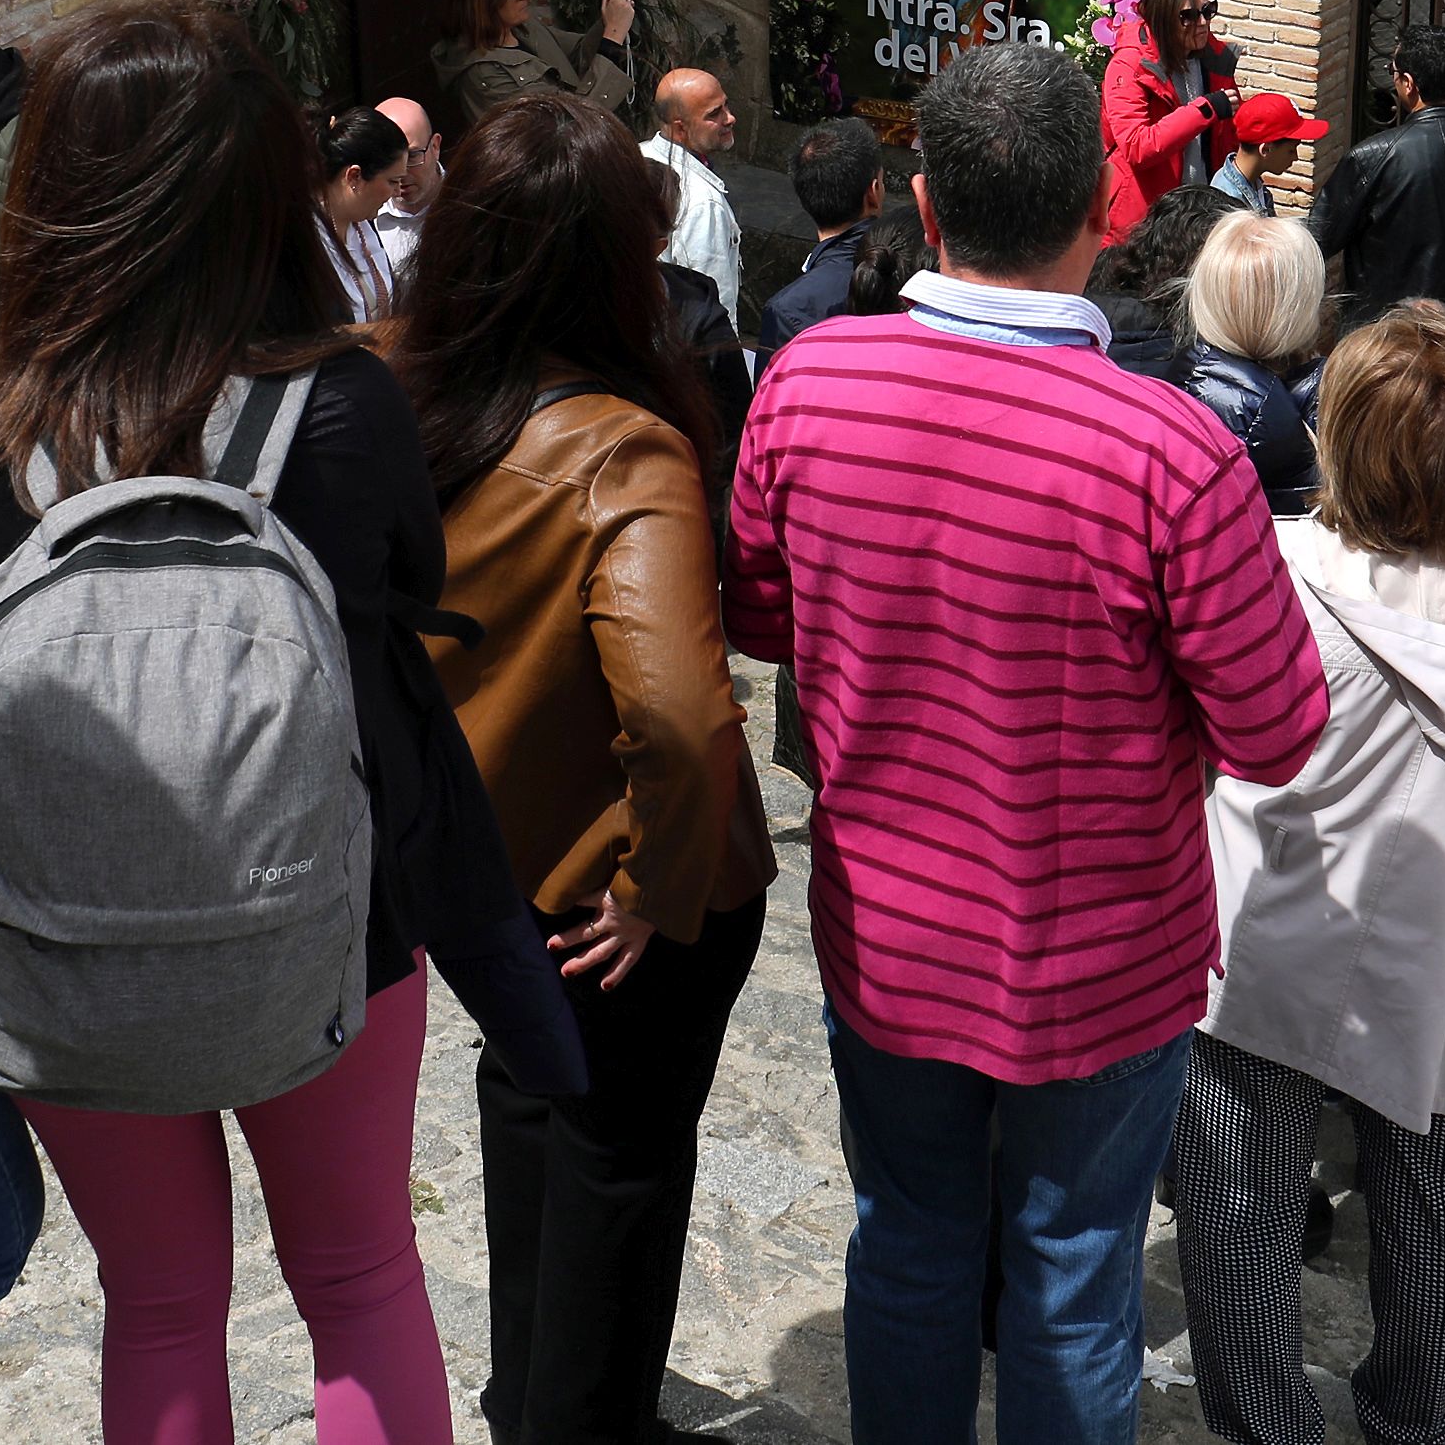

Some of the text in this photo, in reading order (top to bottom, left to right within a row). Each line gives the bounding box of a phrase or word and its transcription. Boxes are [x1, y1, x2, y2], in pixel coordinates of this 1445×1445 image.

[982, 1, 1065, 53] Sra.
[874, 28, 939, 76] del
[249, 857, 315, 886] Pioneer
